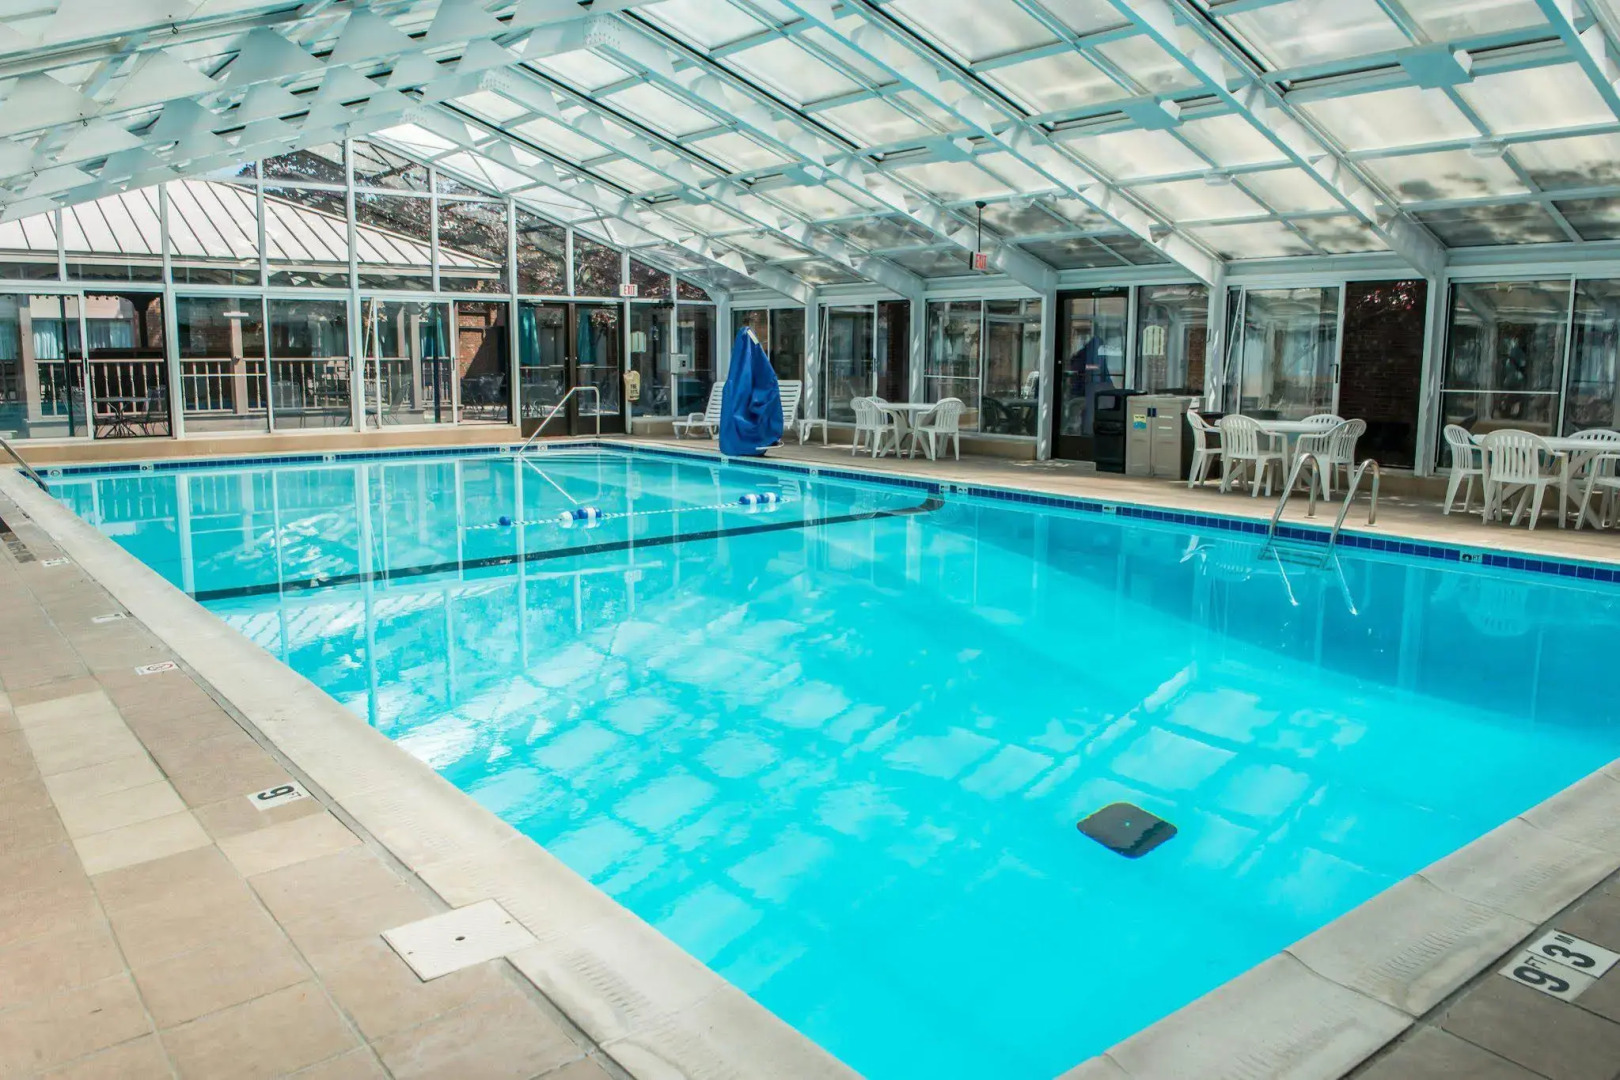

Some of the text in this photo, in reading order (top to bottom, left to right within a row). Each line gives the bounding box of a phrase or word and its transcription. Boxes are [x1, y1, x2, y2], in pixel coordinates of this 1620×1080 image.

[975, 253, 987, 270] EXIT
[623, 285, 635, 296] EXIT
[1523, 956, 1547, 970] FT
[1542, 944, 1596, 968] 3
[1513, 965, 1570, 993] 9
